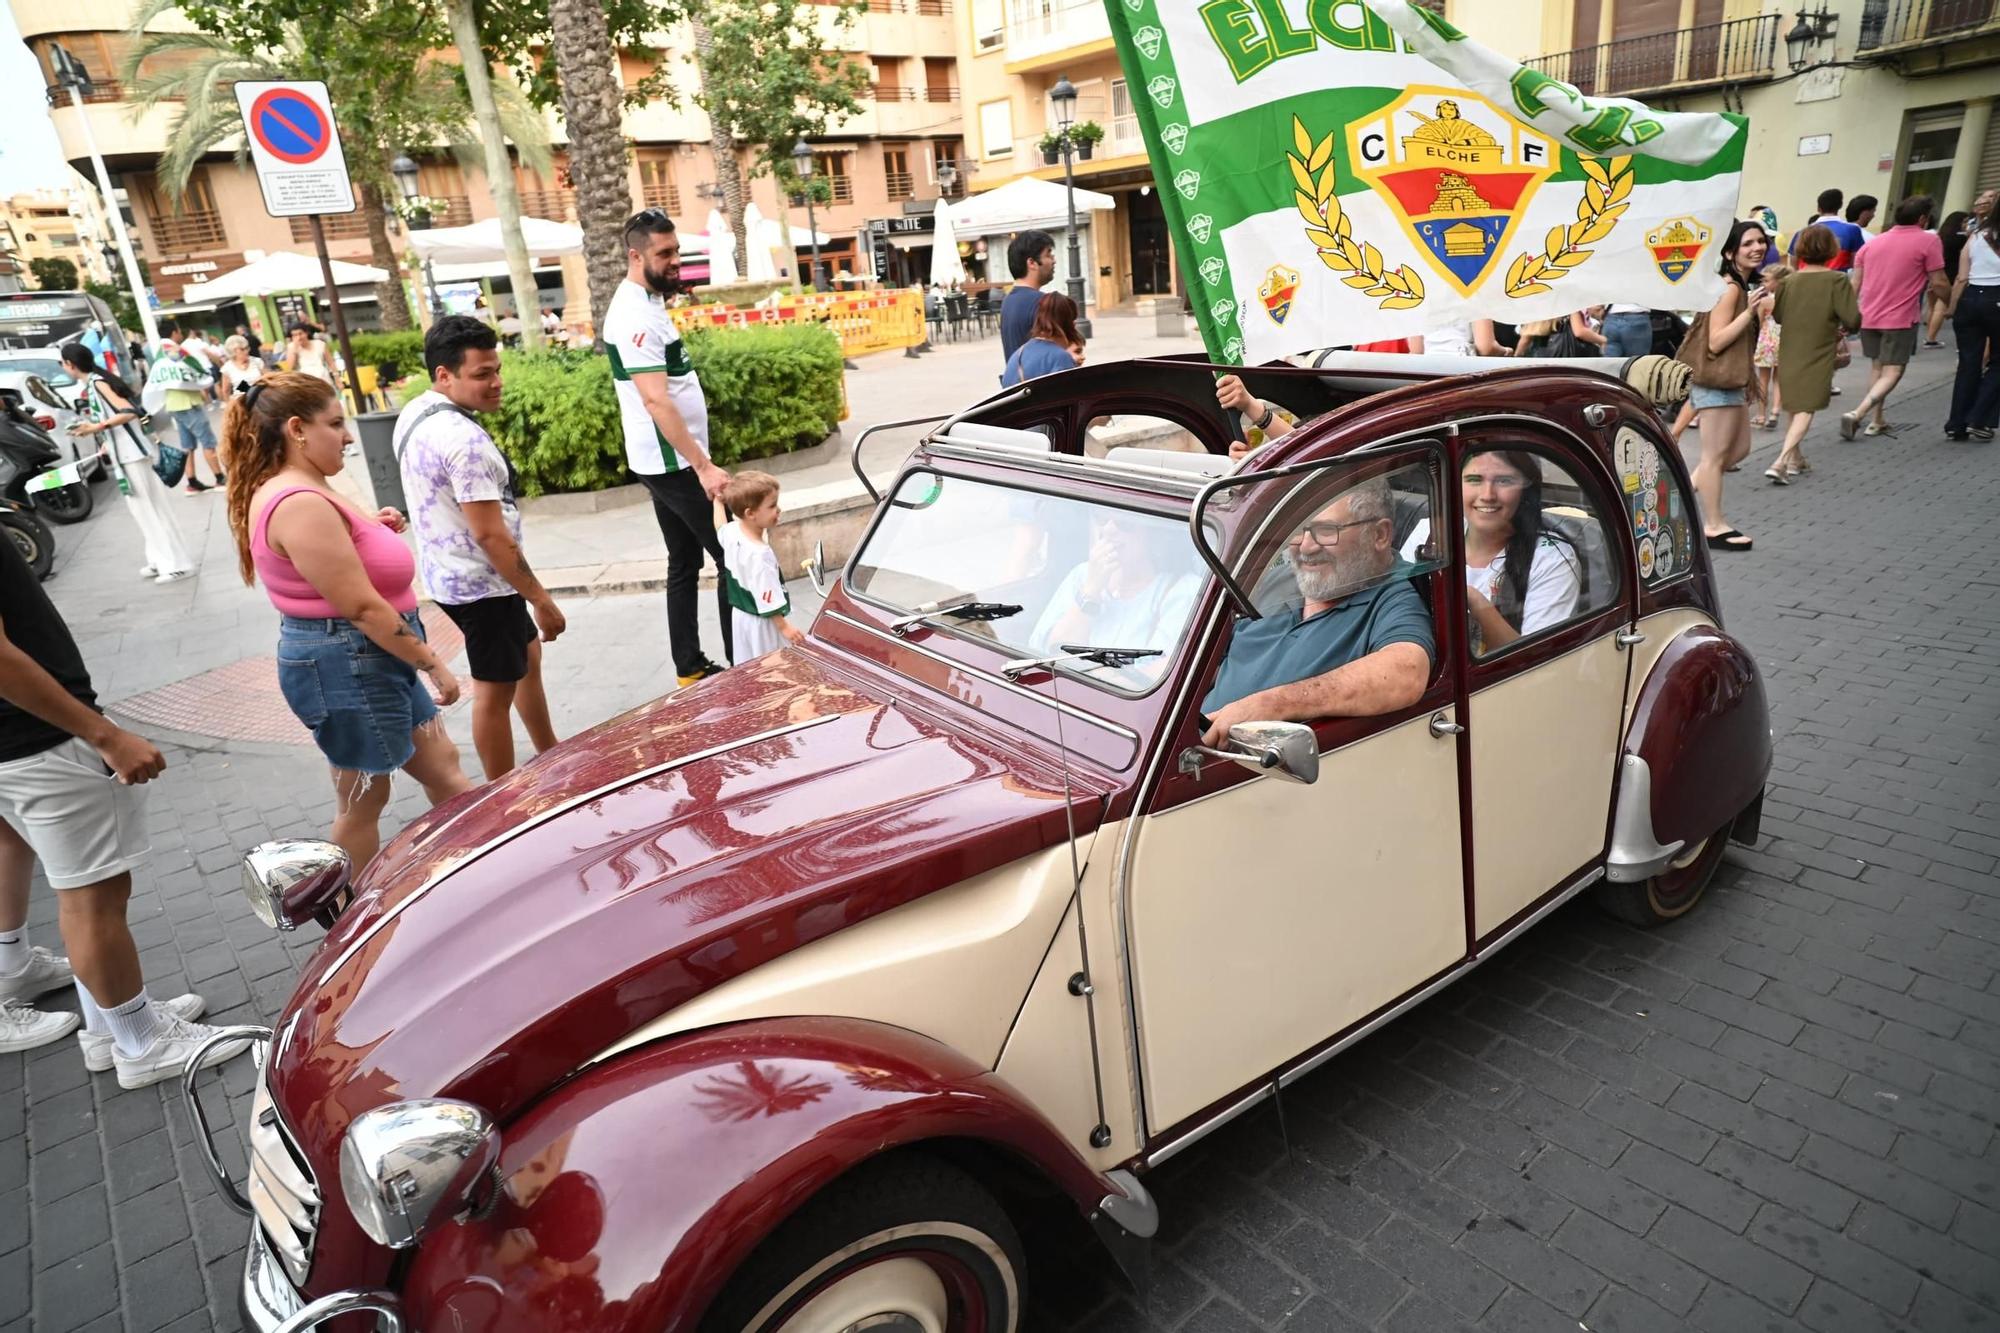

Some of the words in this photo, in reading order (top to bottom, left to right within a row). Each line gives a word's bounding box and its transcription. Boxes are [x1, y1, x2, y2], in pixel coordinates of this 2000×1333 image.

[1361, 134, 1385, 161] C
[1426, 146, 1481, 162] ELCHE
[1523, 143, 1543, 162] F
